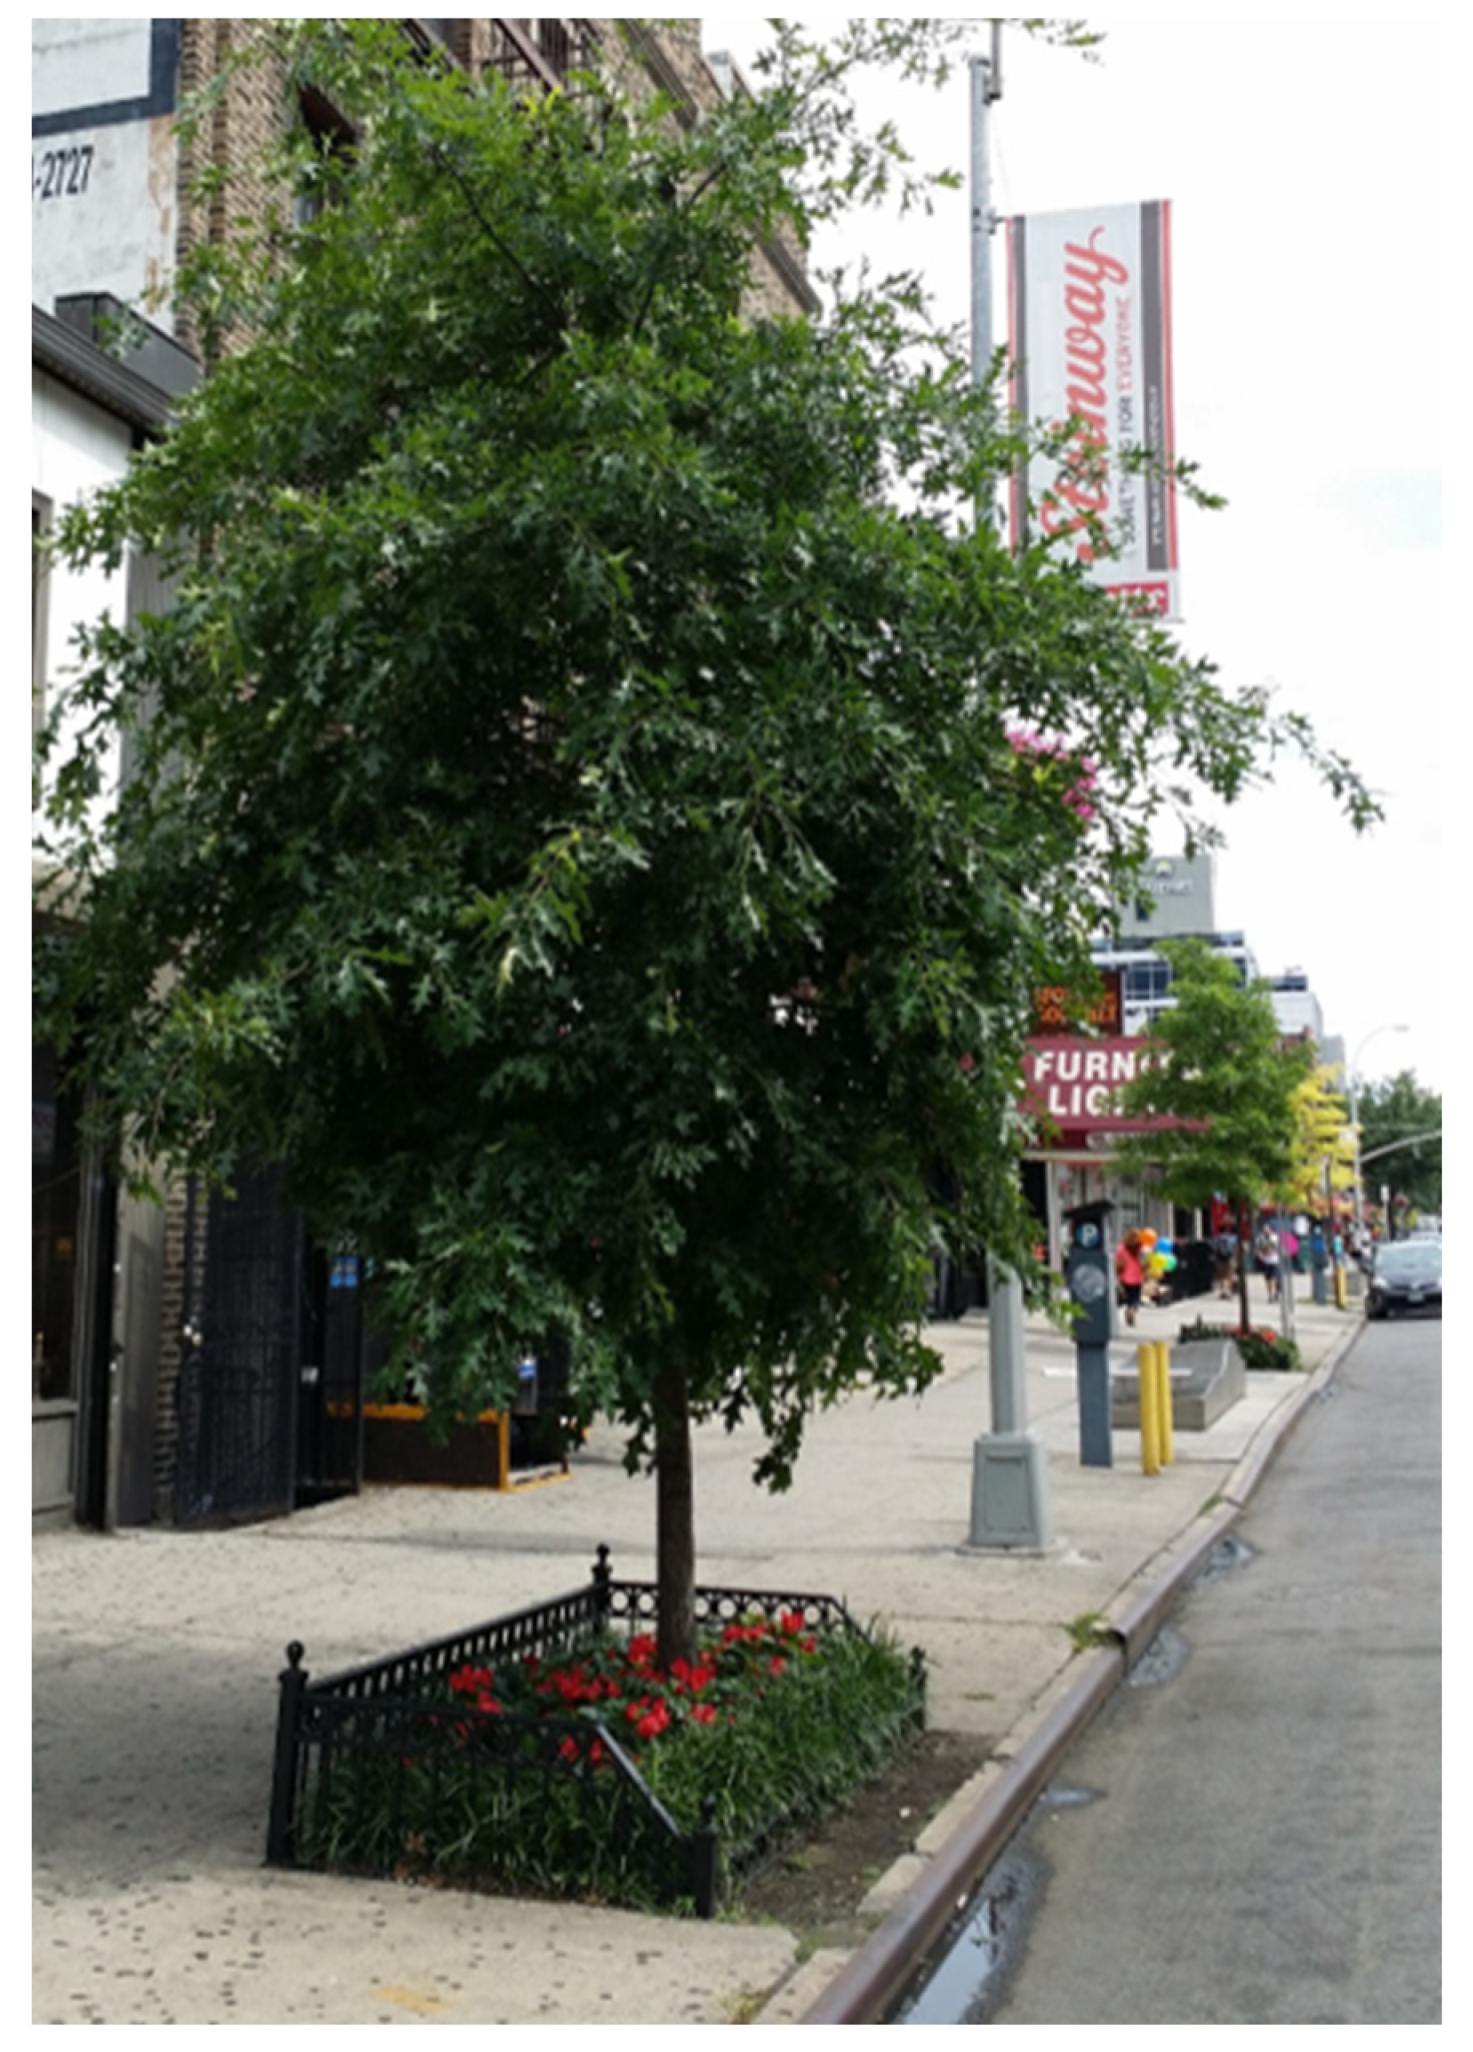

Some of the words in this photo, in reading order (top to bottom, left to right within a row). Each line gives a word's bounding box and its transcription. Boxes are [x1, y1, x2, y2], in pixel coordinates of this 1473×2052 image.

[32, 146, 94, 199] -2727
[1116, 296, 1132, 391] EVERYONE
[1118, 396, 1134, 432] FOR
[1117, 437, 1135, 545] SOMETHG
[1081, 1223, 1099, 1248] P
